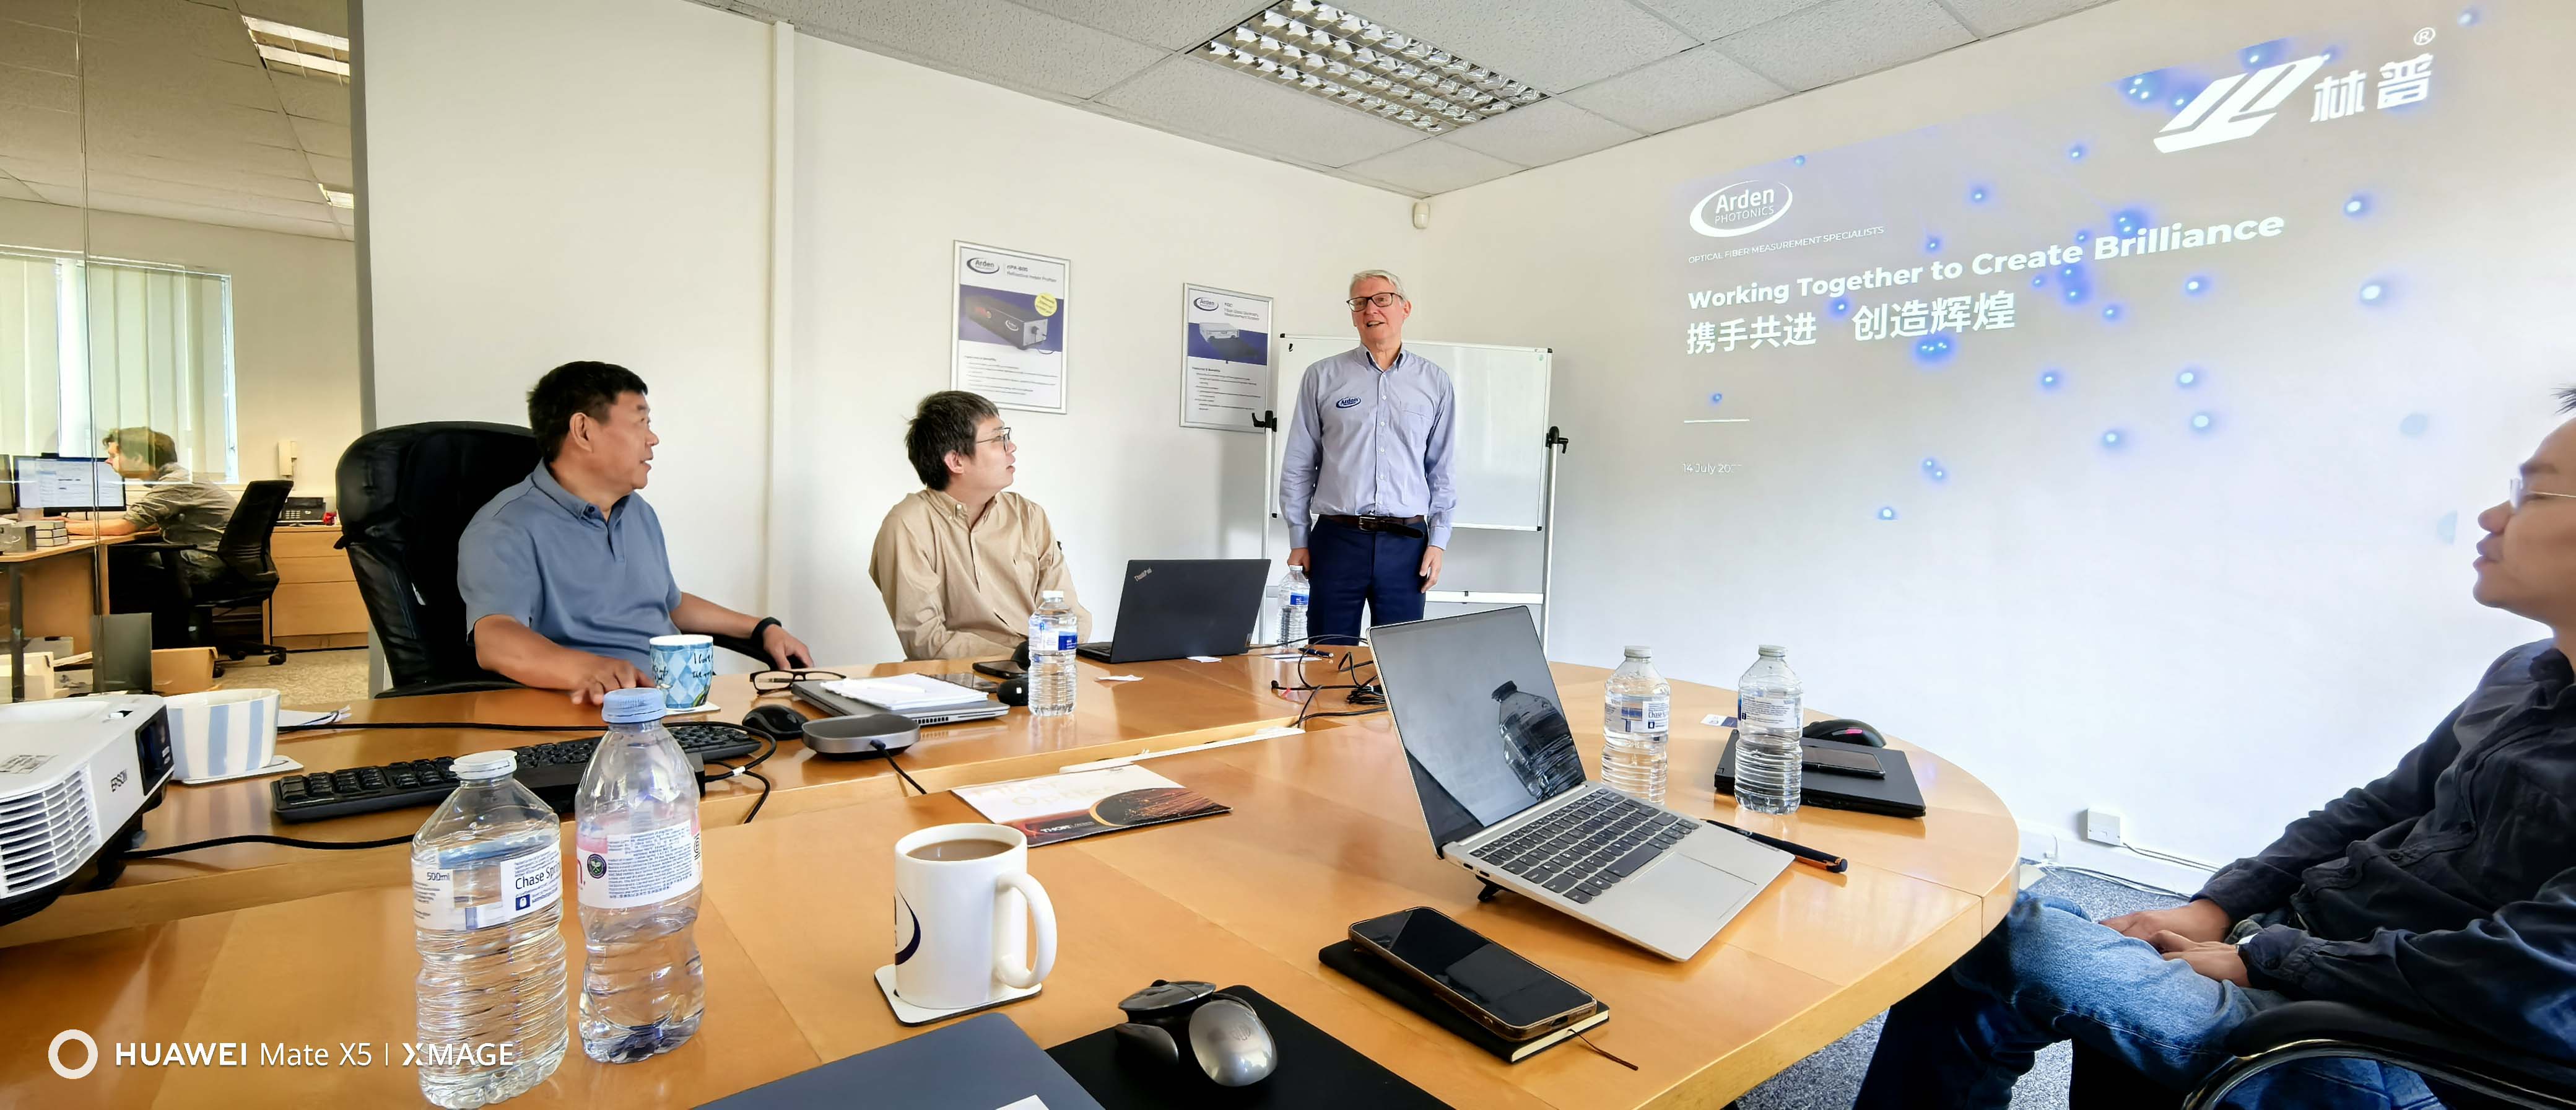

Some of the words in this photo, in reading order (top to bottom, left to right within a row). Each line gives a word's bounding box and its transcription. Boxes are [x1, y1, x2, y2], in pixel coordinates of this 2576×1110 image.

[2310, 53, 2434, 123] 林普
[1715, 188, 1775, 214] Arden
[1715, 205, 1775, 224] PHOTONICS
[1688, 251, 1723, 263] OPTICAL
[1725, 248, 1749, 259] FIBER
[1751, 235, 1821, 253] MEASUREMENT
[1823, 226, 1885, 243] SPECIALISTS
[975, 260, 995, 268] Arden
[1687, 282, 1790, 310] Working
[1797, 266, 1923, 298] Together
[1931, 260, 1962, 281] to
[1972, 243, 2083, 276] Create
[2094, 215, 2285, 260] Brilliance
[1687, 312, 1817, 355] 携手共进
[1852, 290, 2016, 341] 创造辉煌
[1682, 463, 1694, 473] 14
[1695, 462, 1715, 475] July
[426, 872, 451, 881] 500ml
[515, 872, 544, 889] Chase
